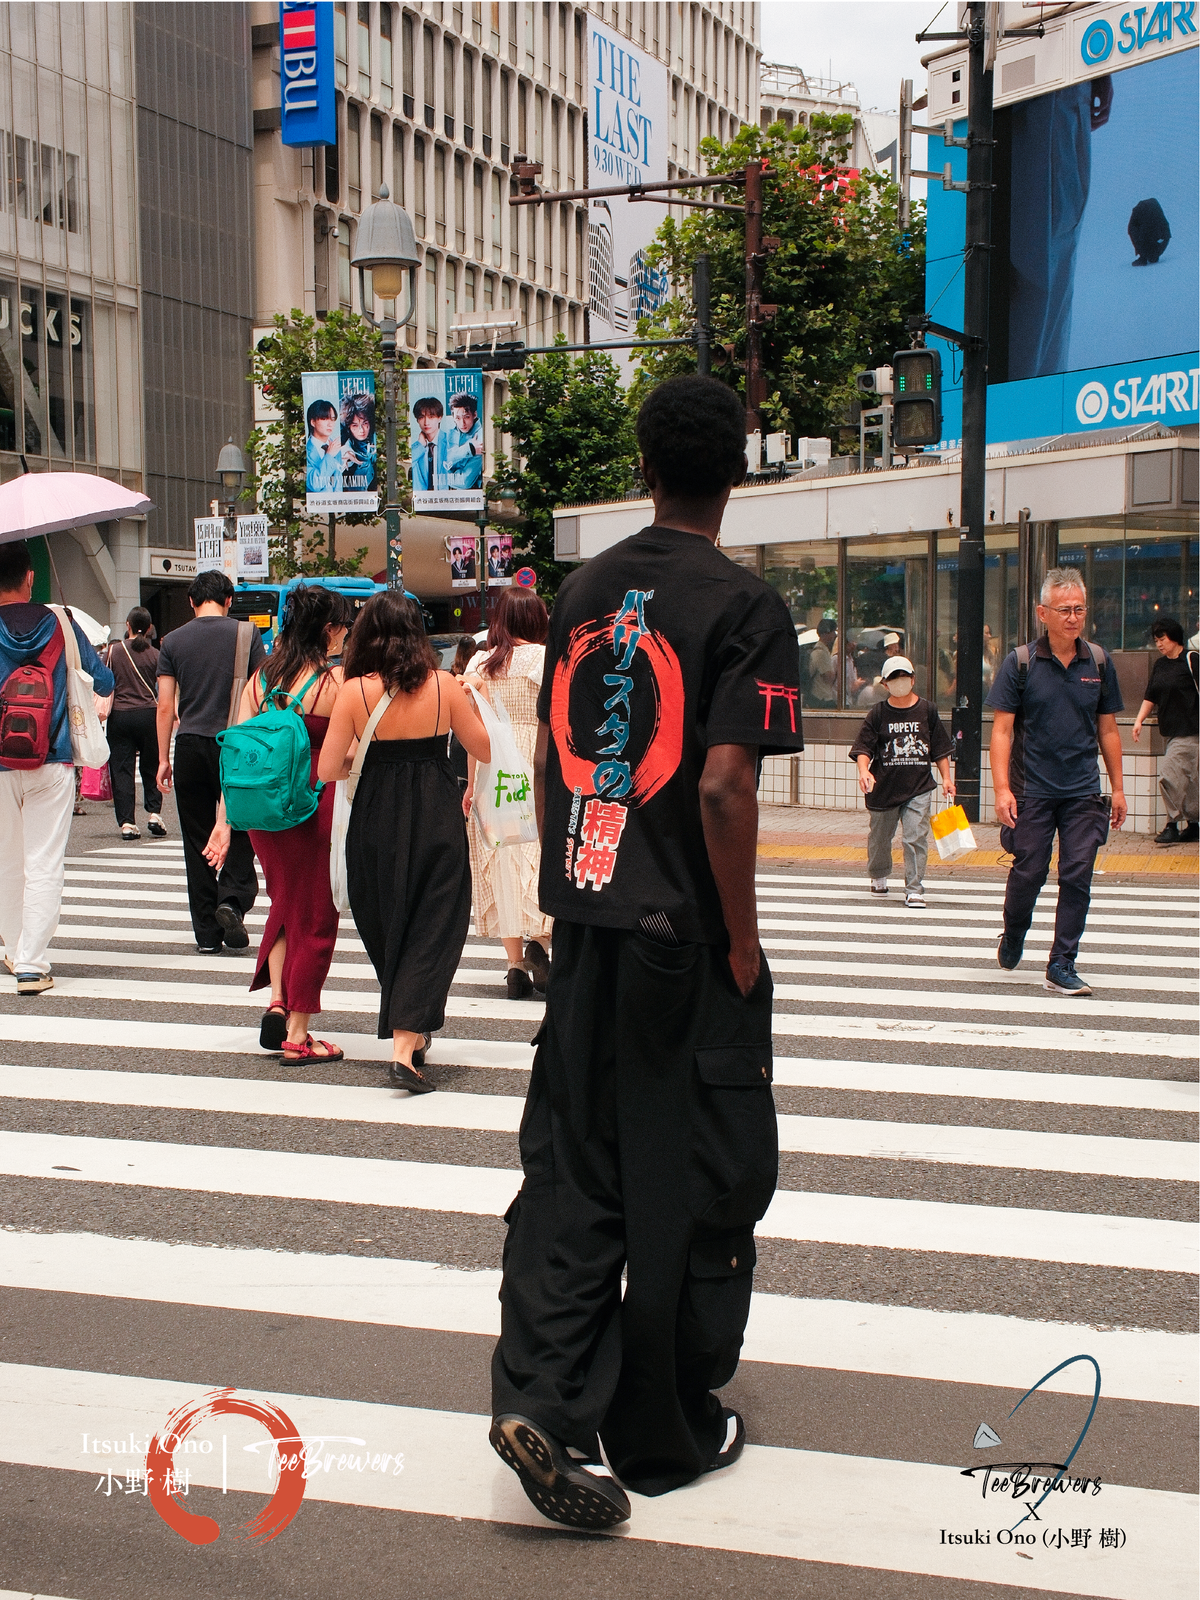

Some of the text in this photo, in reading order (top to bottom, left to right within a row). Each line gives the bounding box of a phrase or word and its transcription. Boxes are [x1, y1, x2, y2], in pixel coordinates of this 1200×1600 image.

[283, 2, 317, 115] IBU
[592, 30, 641, 107] THE
[593, 85, 653, 168] LAST
[590, 588, 655, 798] バリスタの
[888, 722, 920, 734] POPEYE
[564, 836, 575, 882] SPIRIT
[573, 798, 629, 892] 精神
